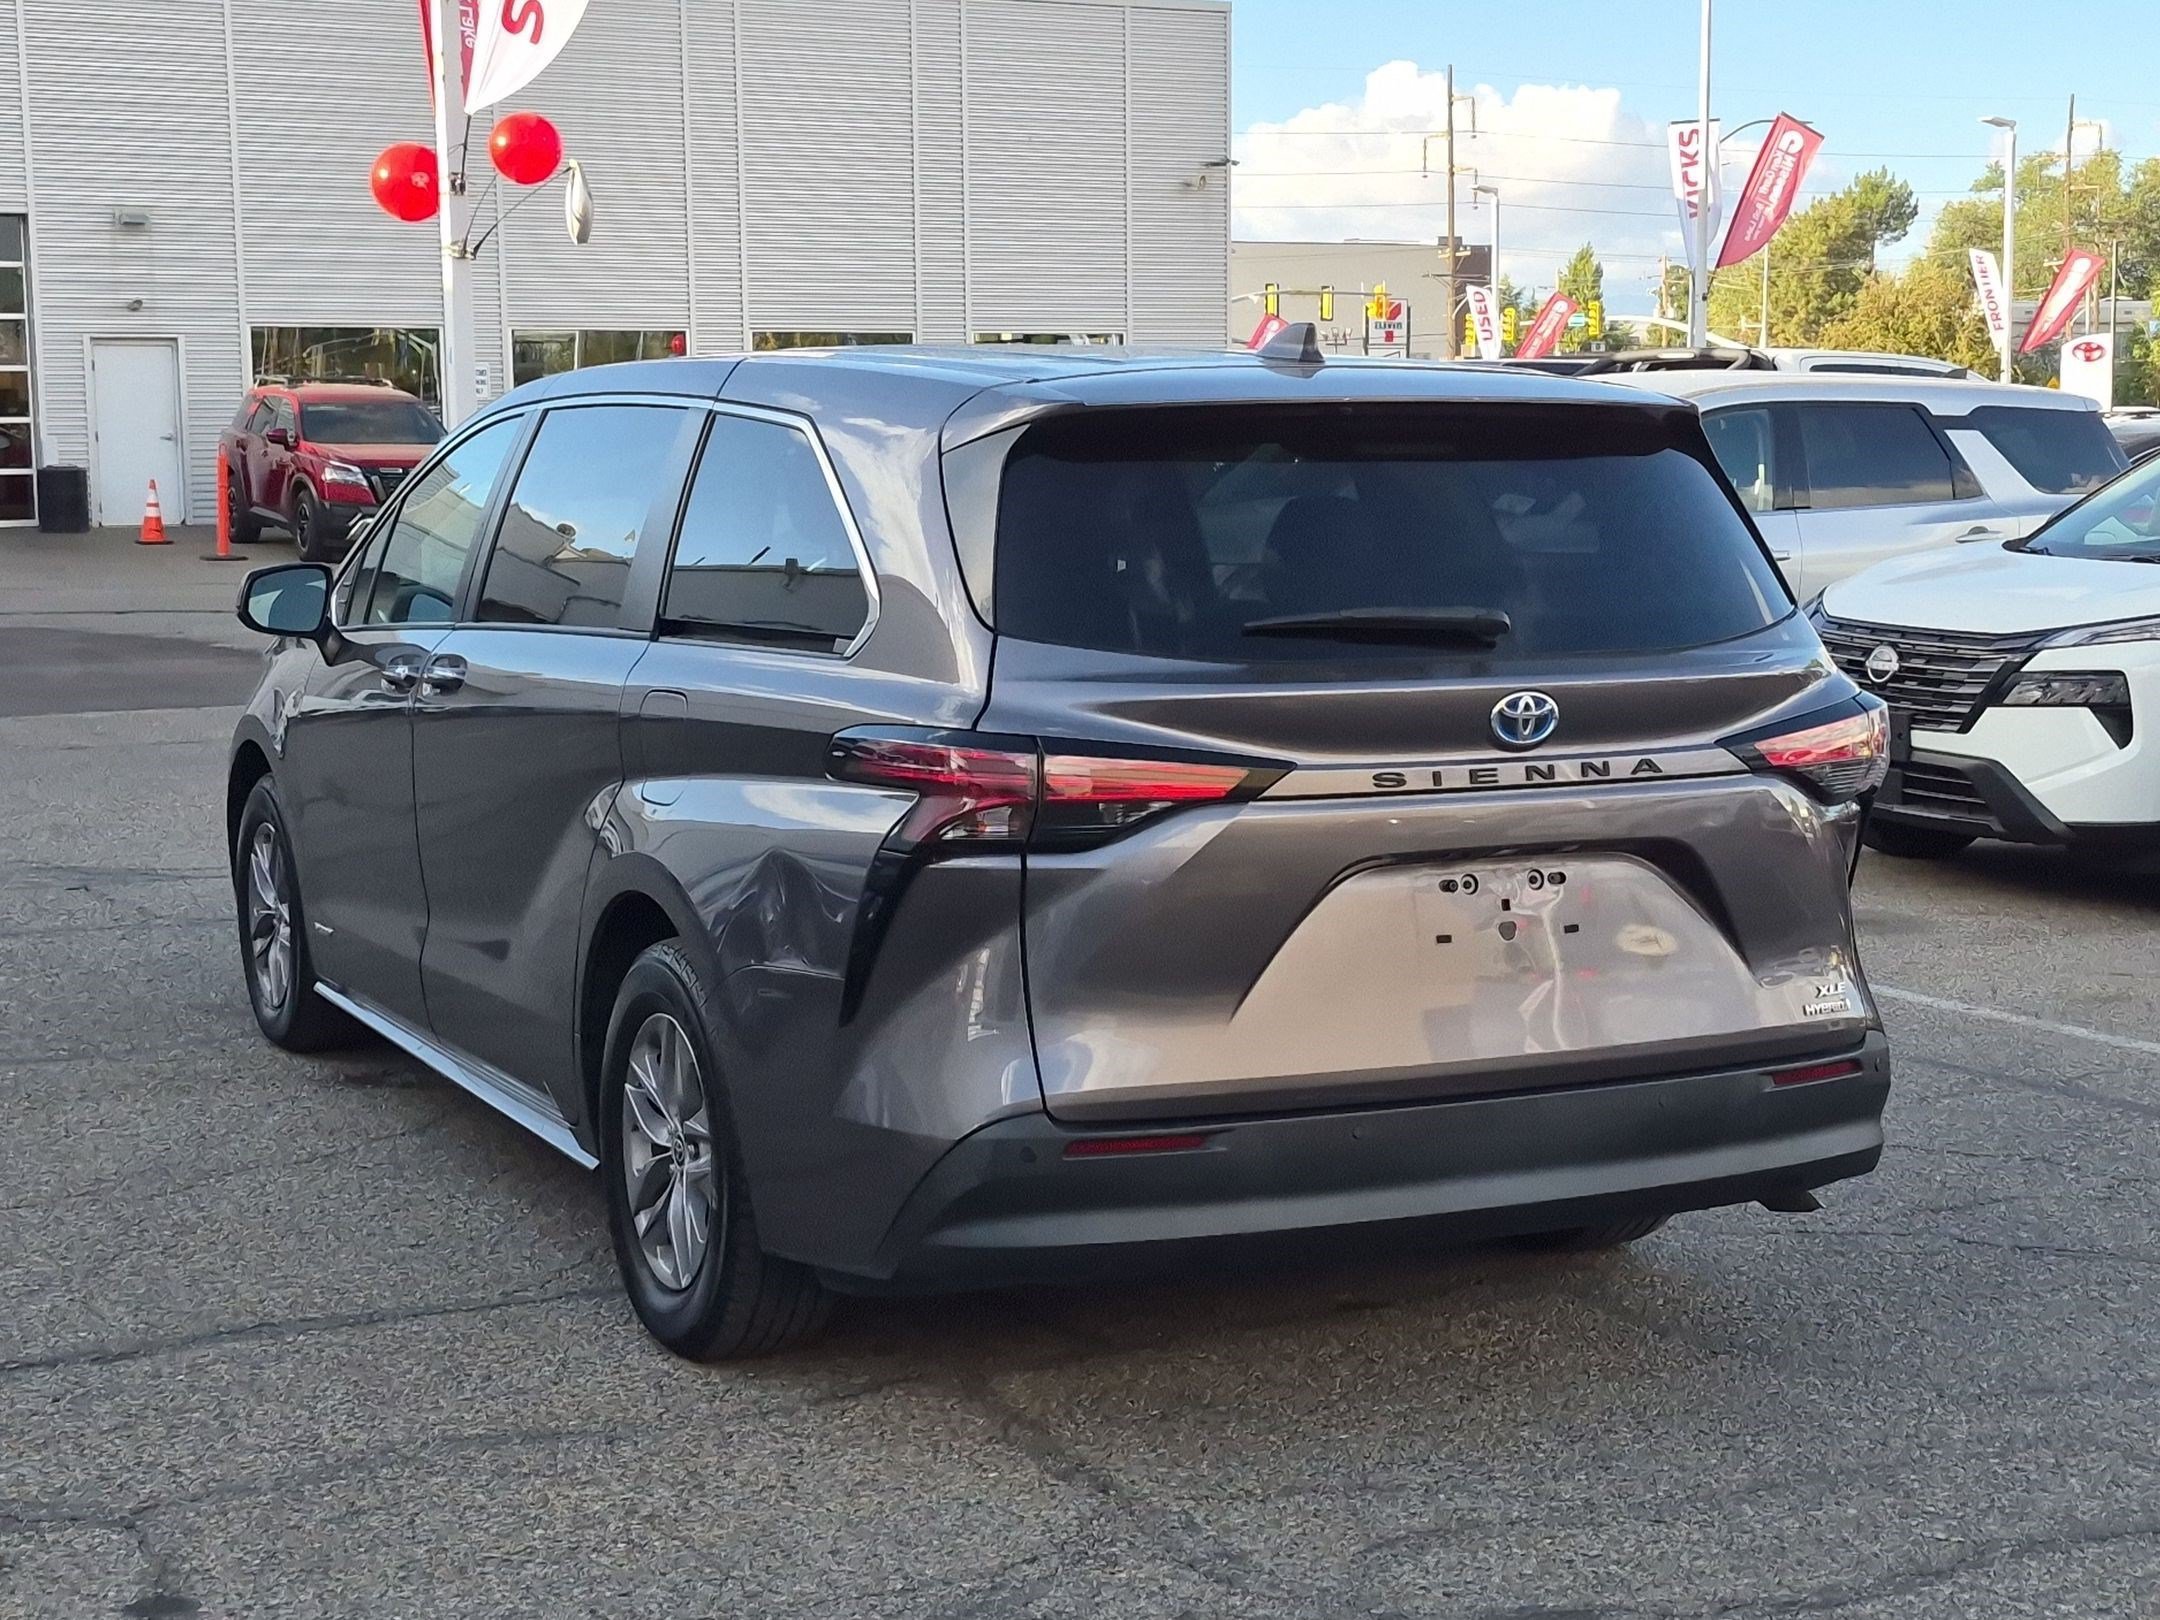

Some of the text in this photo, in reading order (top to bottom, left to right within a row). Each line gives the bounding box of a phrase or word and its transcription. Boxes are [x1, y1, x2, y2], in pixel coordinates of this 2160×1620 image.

[1473, 291, 1493, 341] USED
[1371, 758, 1664, 789] SIENNA
[1815, 982, 1846, 998] XLE
